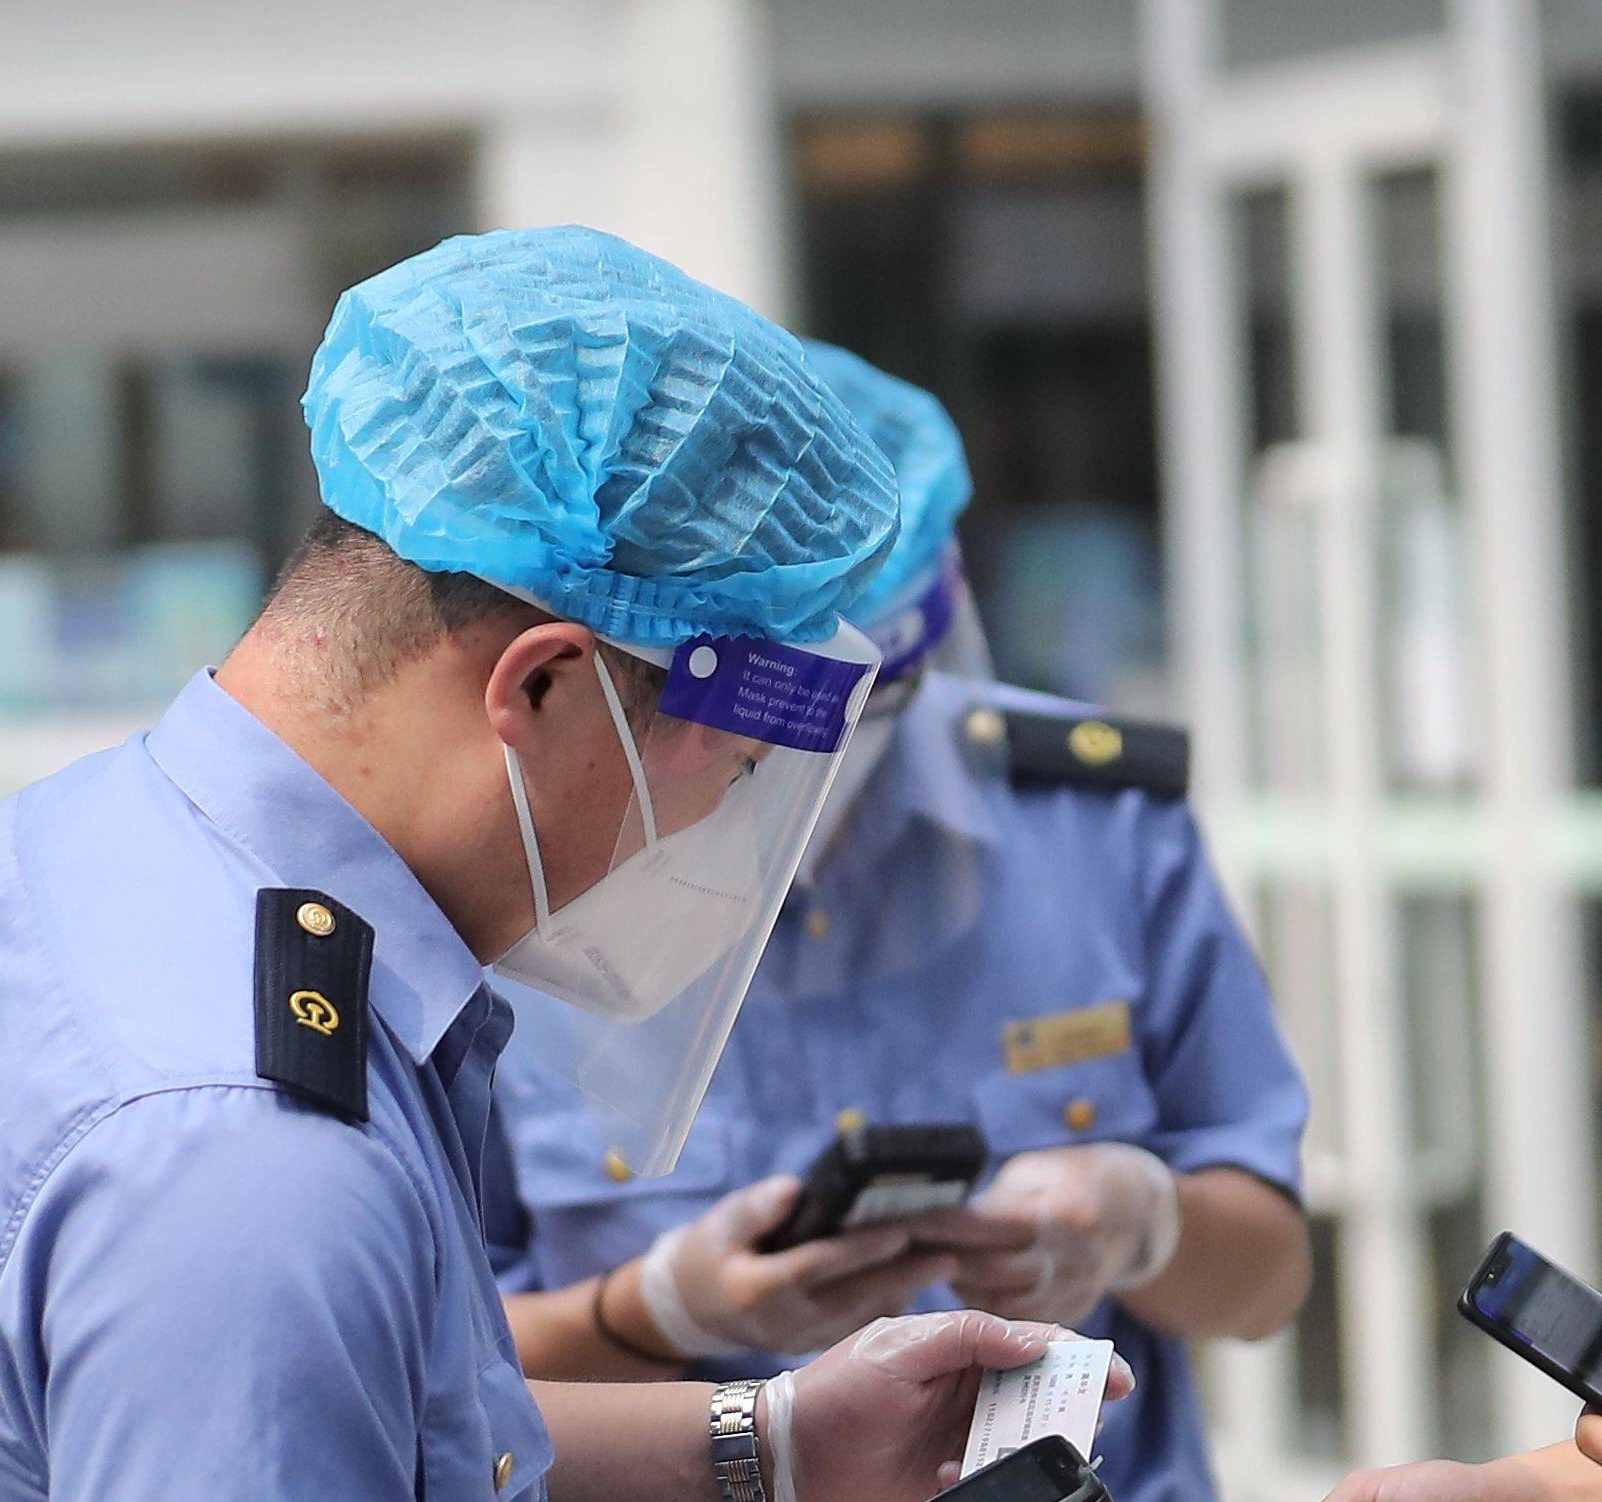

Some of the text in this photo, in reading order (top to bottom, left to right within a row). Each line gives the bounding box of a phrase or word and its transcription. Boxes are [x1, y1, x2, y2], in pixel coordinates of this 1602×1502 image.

[748, 652, 798, 677] Warning:
[752, 675, 773, 687] can
[774, 681, 797, 696] only
[798, 684, 810, 698] be
[738, 686, 766, 704] Mask
[767, 697, 806, 714] prevent
[733, 703, 762, 719] liquid
[763, 711, 786, 727] from
